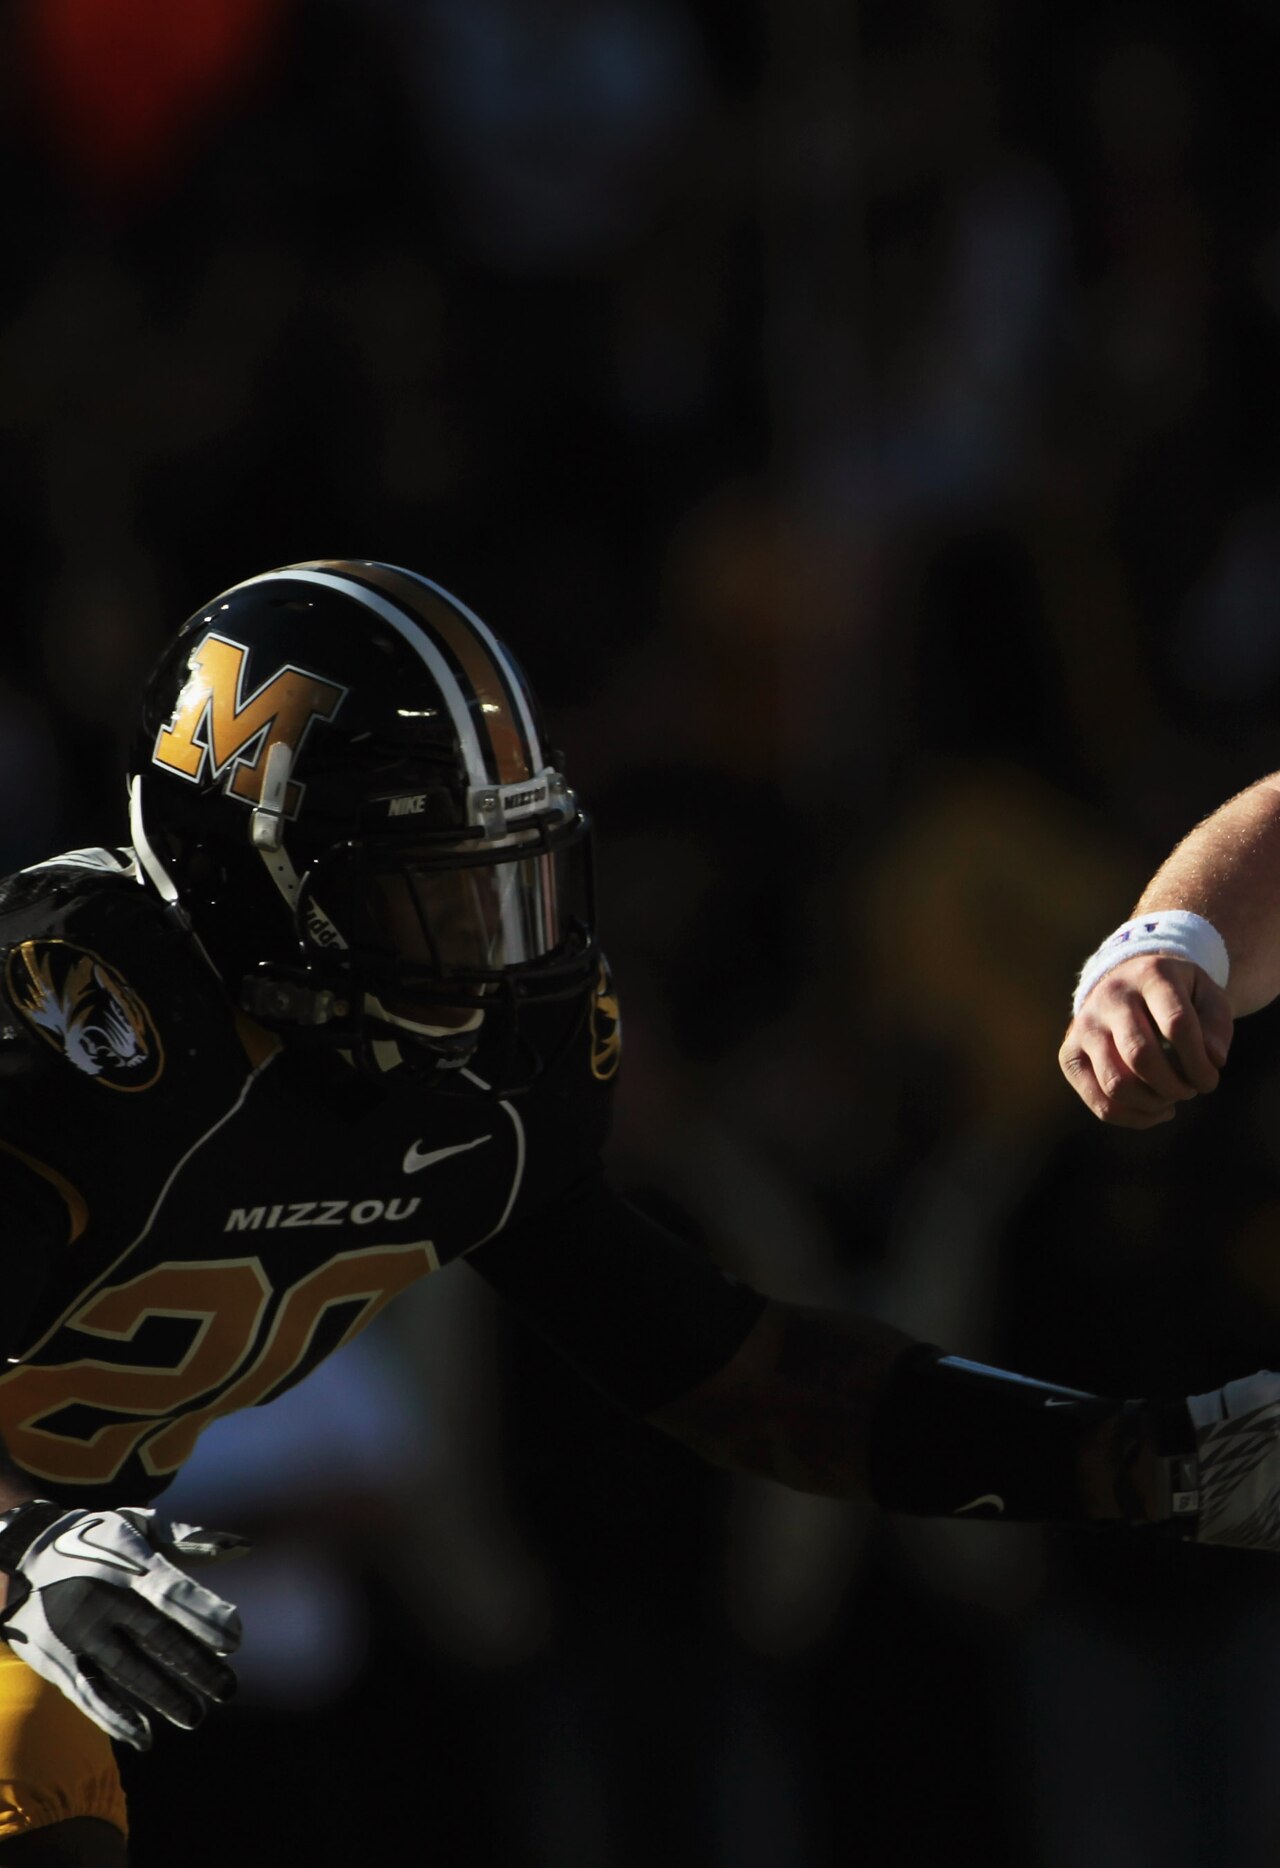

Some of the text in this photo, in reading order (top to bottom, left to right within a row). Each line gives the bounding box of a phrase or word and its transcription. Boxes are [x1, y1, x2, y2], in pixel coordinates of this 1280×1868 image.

[151, 631, 350, 822] M
[387, 794, 428, 816] NIKE
[223, 1197, 422, 1233] MIZZOU
[0, 1239, 442, 1486] 20
